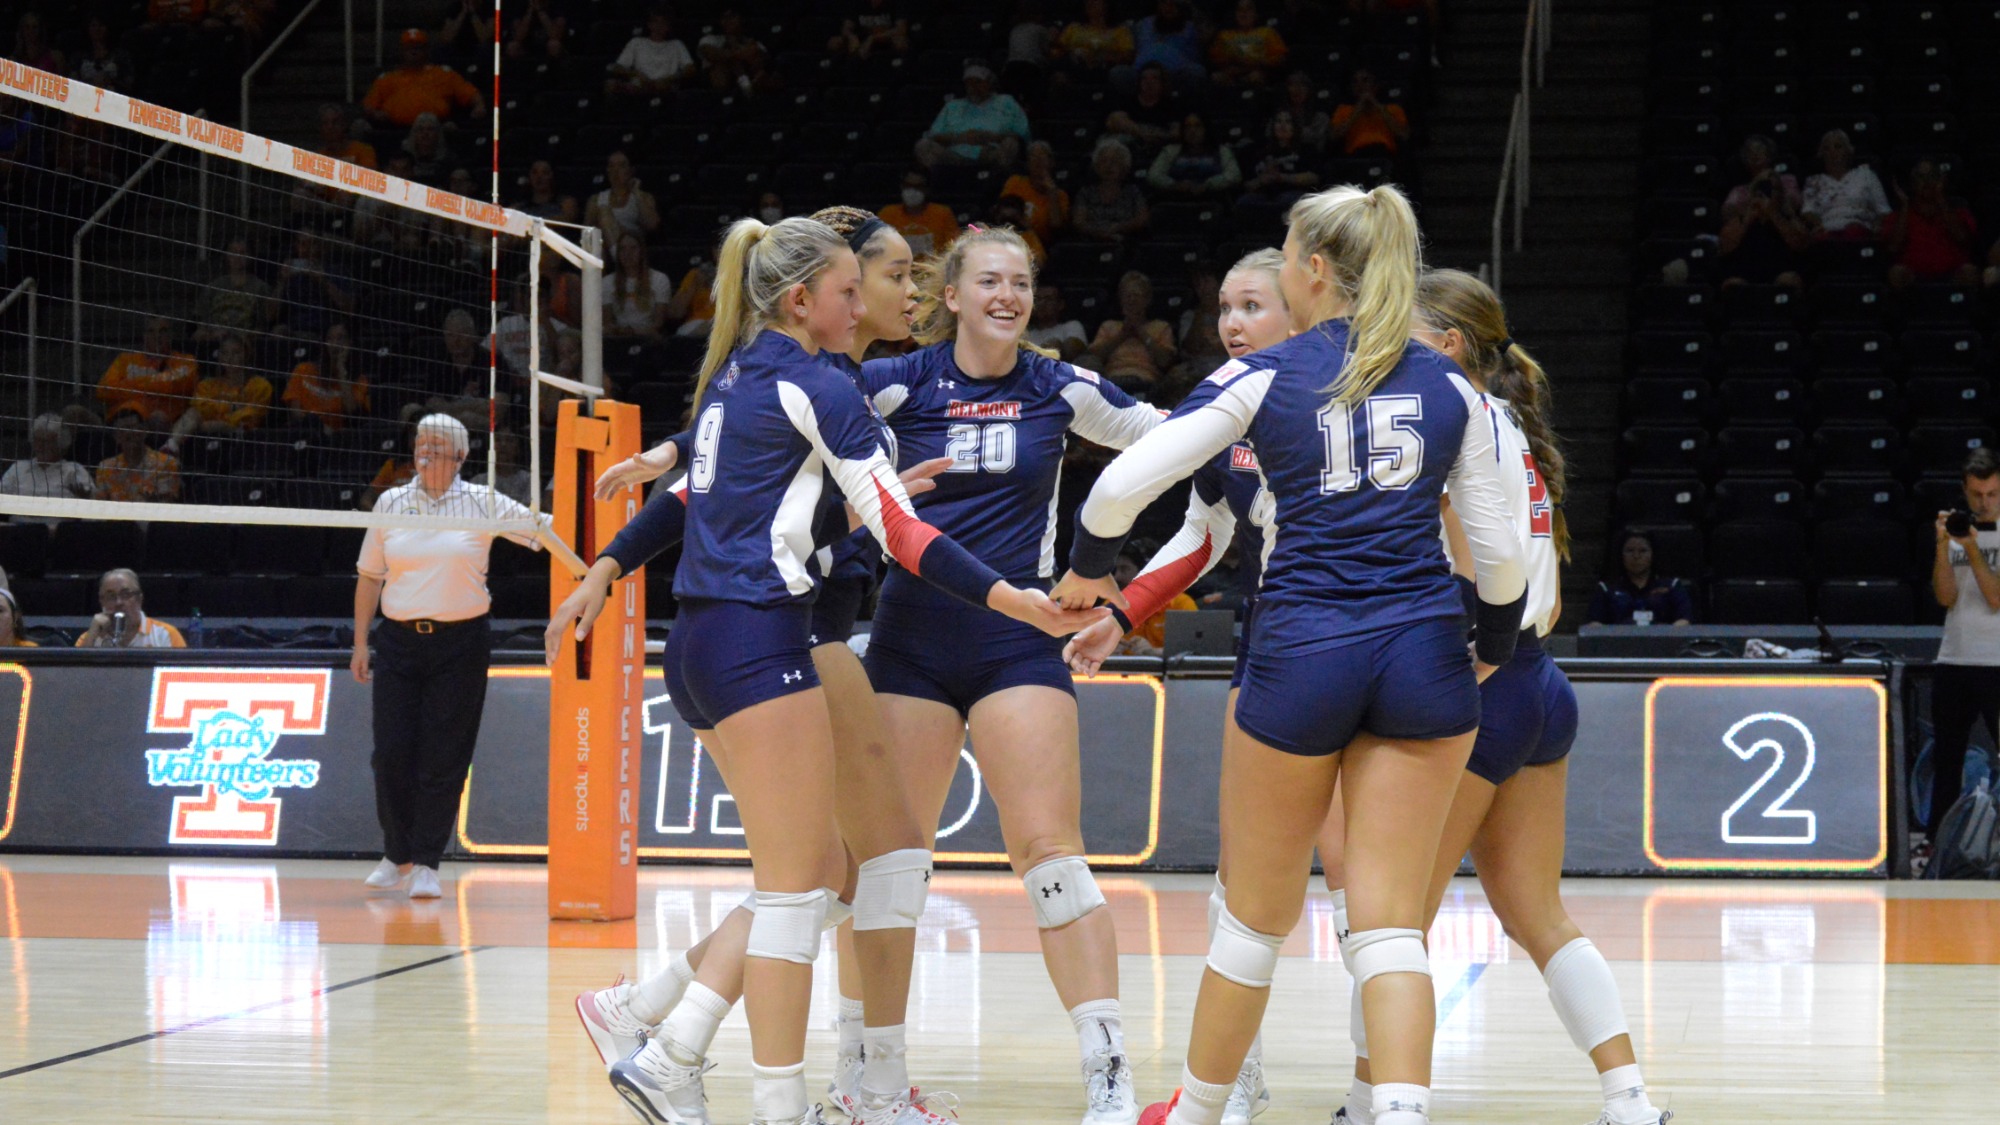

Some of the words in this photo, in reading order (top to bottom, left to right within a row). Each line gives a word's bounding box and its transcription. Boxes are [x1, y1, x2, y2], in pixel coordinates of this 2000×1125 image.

[128, 98, 181, 135] TENNESSEE
[187, 115, 244, 153] VOLUNTEERS
[292, 148, 335, 181] TENNESSEE
[339, 163, 387, 194] VOLUNTEERS
[426, 187, 462, 216] TENNESSEE
[945, 399, 1021, 420] BELMONT
[691, 402, 724, 493] 9
[945, 422, 1017, 473] 20
[1317, 394, 1424, 495] 15
[193, 711, 275, 759] Lady
[575, 707, 590, 761] sports
[149, 752, 316, 800] Volunteers
[1722, 712, 1816, 844] 2
